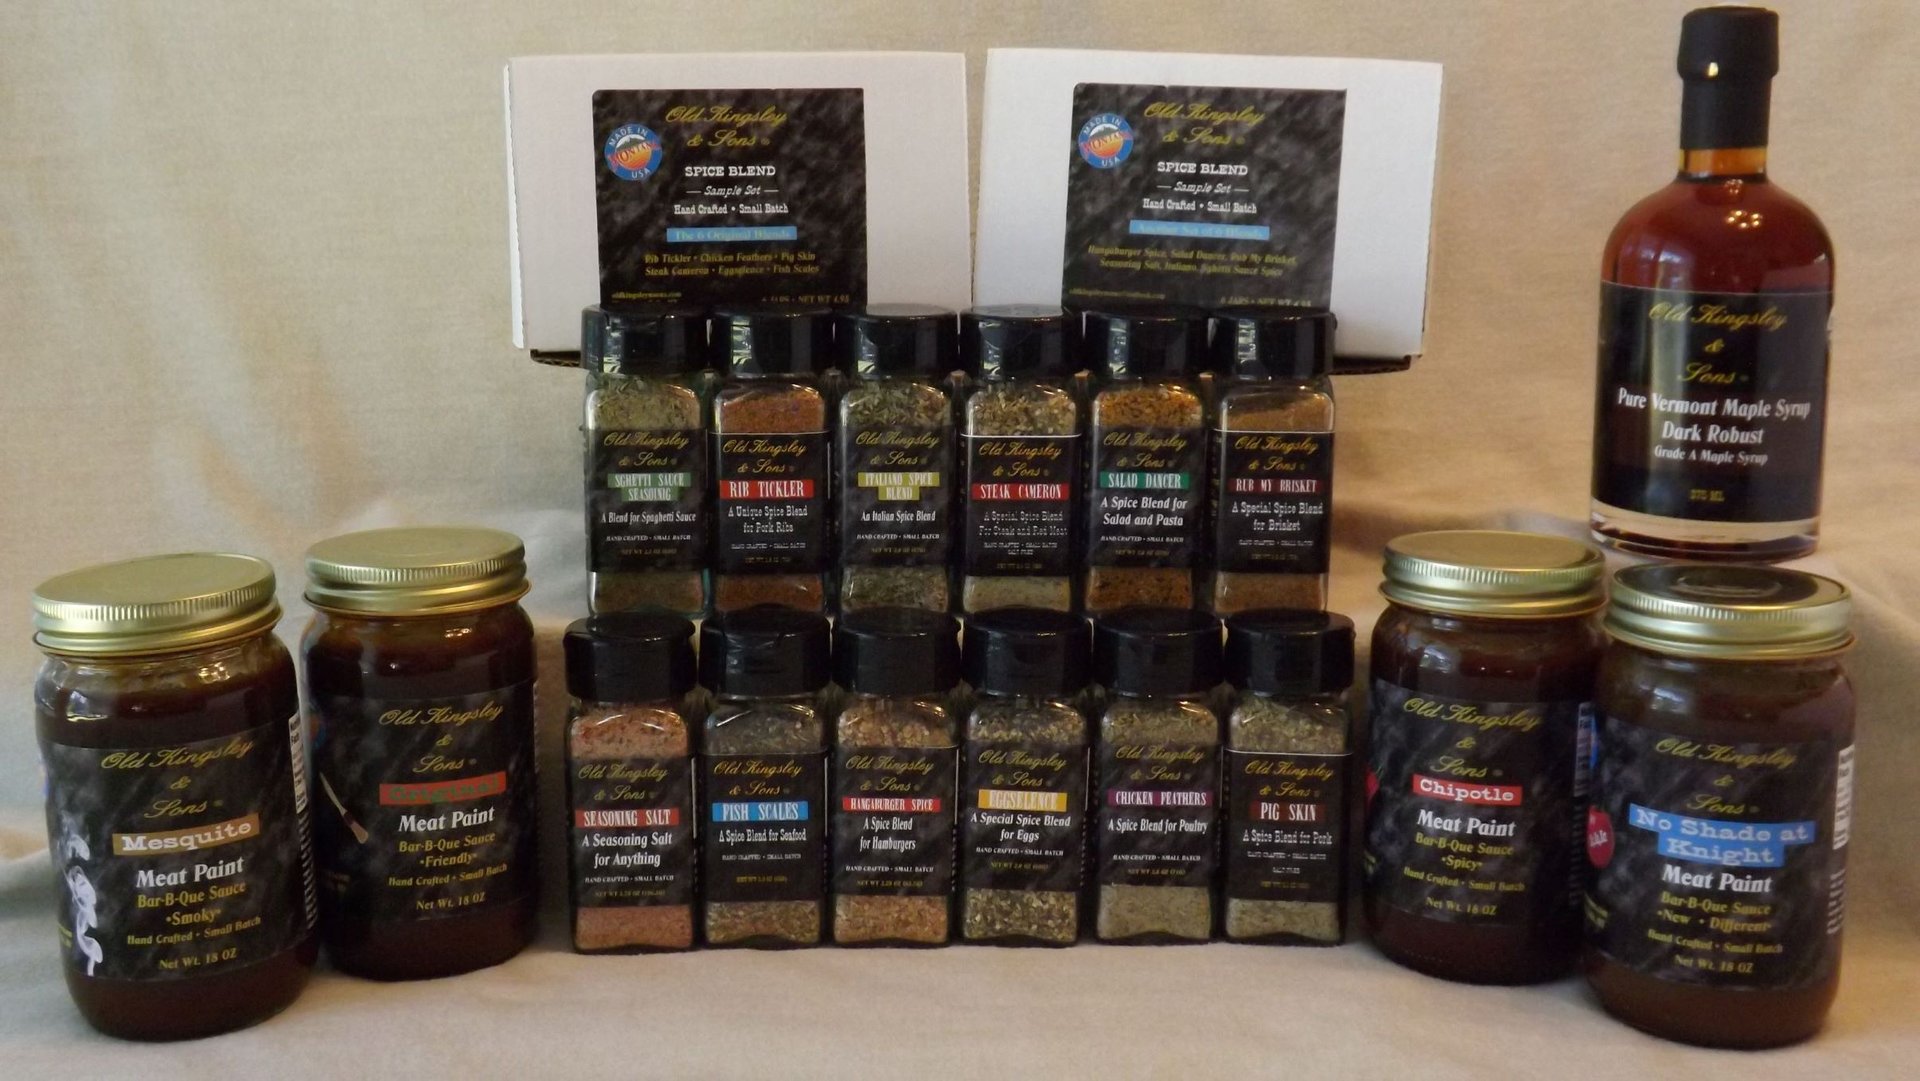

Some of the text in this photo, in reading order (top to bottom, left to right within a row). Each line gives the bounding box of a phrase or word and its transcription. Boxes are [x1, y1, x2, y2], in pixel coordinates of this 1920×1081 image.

[665, 104, 788, 128] Old Kingsley
[1144, 102, 1265, 125] Old Kingsley
[686, 129, 756, 147] & Sons
[1162, 127, 1232, 144] & Sons
[631, 167, 651, 179] USA
[684, 165, 776, 177] SPICE BLEND
[1157, 162, 1249, 176] SPICE BLEND
[704, 185, 761, 198] Sample Set
[1174, 181, 1232, 195] Sample Set
[673, 203, 789, 215] Hand Crafted Small Batch
[1142, 198, 1257, 214] Hand Crafted Small Batch
[1648, 302, 1787, 332] Old Kingsley
[1704, 338, 1725, 353] &
[1677, 362, 1736, 385] Sons
[1618, 387, 1811, 421] Pure Vermont Maple Syrup
[1661, 421, 1764, 445] Dark Robust
[1654, 445, 1768, 466] Grade A Maple Syrup
[659, 472, 684, 487] SAUCE
[865, 472, 933, 486] ITALIANO SPICE
[1108, 473, 1181, 489] SALAD DANCER
[1236, 478, 1317, 493] RUB MY BRISKET
[729, 480, 804, 498] RIB TICKLER
[886, 487, 912, 500] BLEND
[980, 484, 1062, 499] STEAK CAMERON
[1100, 496, 1188, 511] A Spice Blend for
[872, 511, 894, 521] Italian
[896, 510, 914, 523] Spice
[916, 511, 936, 521] Blend
[1103, 513, 1184, 526] Salad and Pasta
[379, 700, 503, 727] Old Kingsley
[436, 735, 453, 747] &
[101, 736, 254, 769] Old Kingsley
[412, 755, 464, 774] Sons
[170, 776, 192, 790] &
[1420, 778, 1514, 802] Chipotle
[911, 798, 933, 811] SPICE
[1115, 791, 1207, 806] CHICKEN FEATHERS
[143, 799, 207, 819] Sons
[584, 809, 671, 827] SEASONING SALT
[722, 801, 799, 821] FISH SCALES
[1260, 802, 1316, 821] PIG SKIN
[399, 806, 495, 833] Meat Paint
[863, 817, 913, 832] A Spice Blend
[970, 812, 1071, 827] A Special Spice Blend
[1108, 818, 1208, 834] A Spice Blend for Poultry
[1417, 809, 1517, 837] Meat Paint
[1636, 808, 1808, 843] No Shade at
[121, 820, 252, 852] Mesquite
[399, 831, 496, 853] Bar-B-Que Sauce
[582, 831, 673, 849] A Seasoning Salt
[725, 829, 745, 846] Spice
[746, 829, 767, 842] Blend
[768, 829, 779, 841] for
[780, 828, 807, 841] Seafood
[860, 836, 916, 853] for Hamburgers
[1000, 829, 1040, 843] for Eggs
[1415, 832, 1514, 856] Bar-B-Que Sauce
[594, 851, 661, 869] for Anything
[1667, 838, 1775, 866] Knight
[136, 856, 245, 889] Meat Paint
[1662, 864, 1773, 893] Meat Paint
[137, 882, 246, 909] Bar-B-Que Sauce
[1661, 891, 1771, 916] Bar-B-Que Sauce
[127, 916, 261, 945] Hand Crafted Small Batch
[159, 959, 178, 970] Net
[205, 952, 218, 964] 18
[222, 948, 237, 961] OZ
